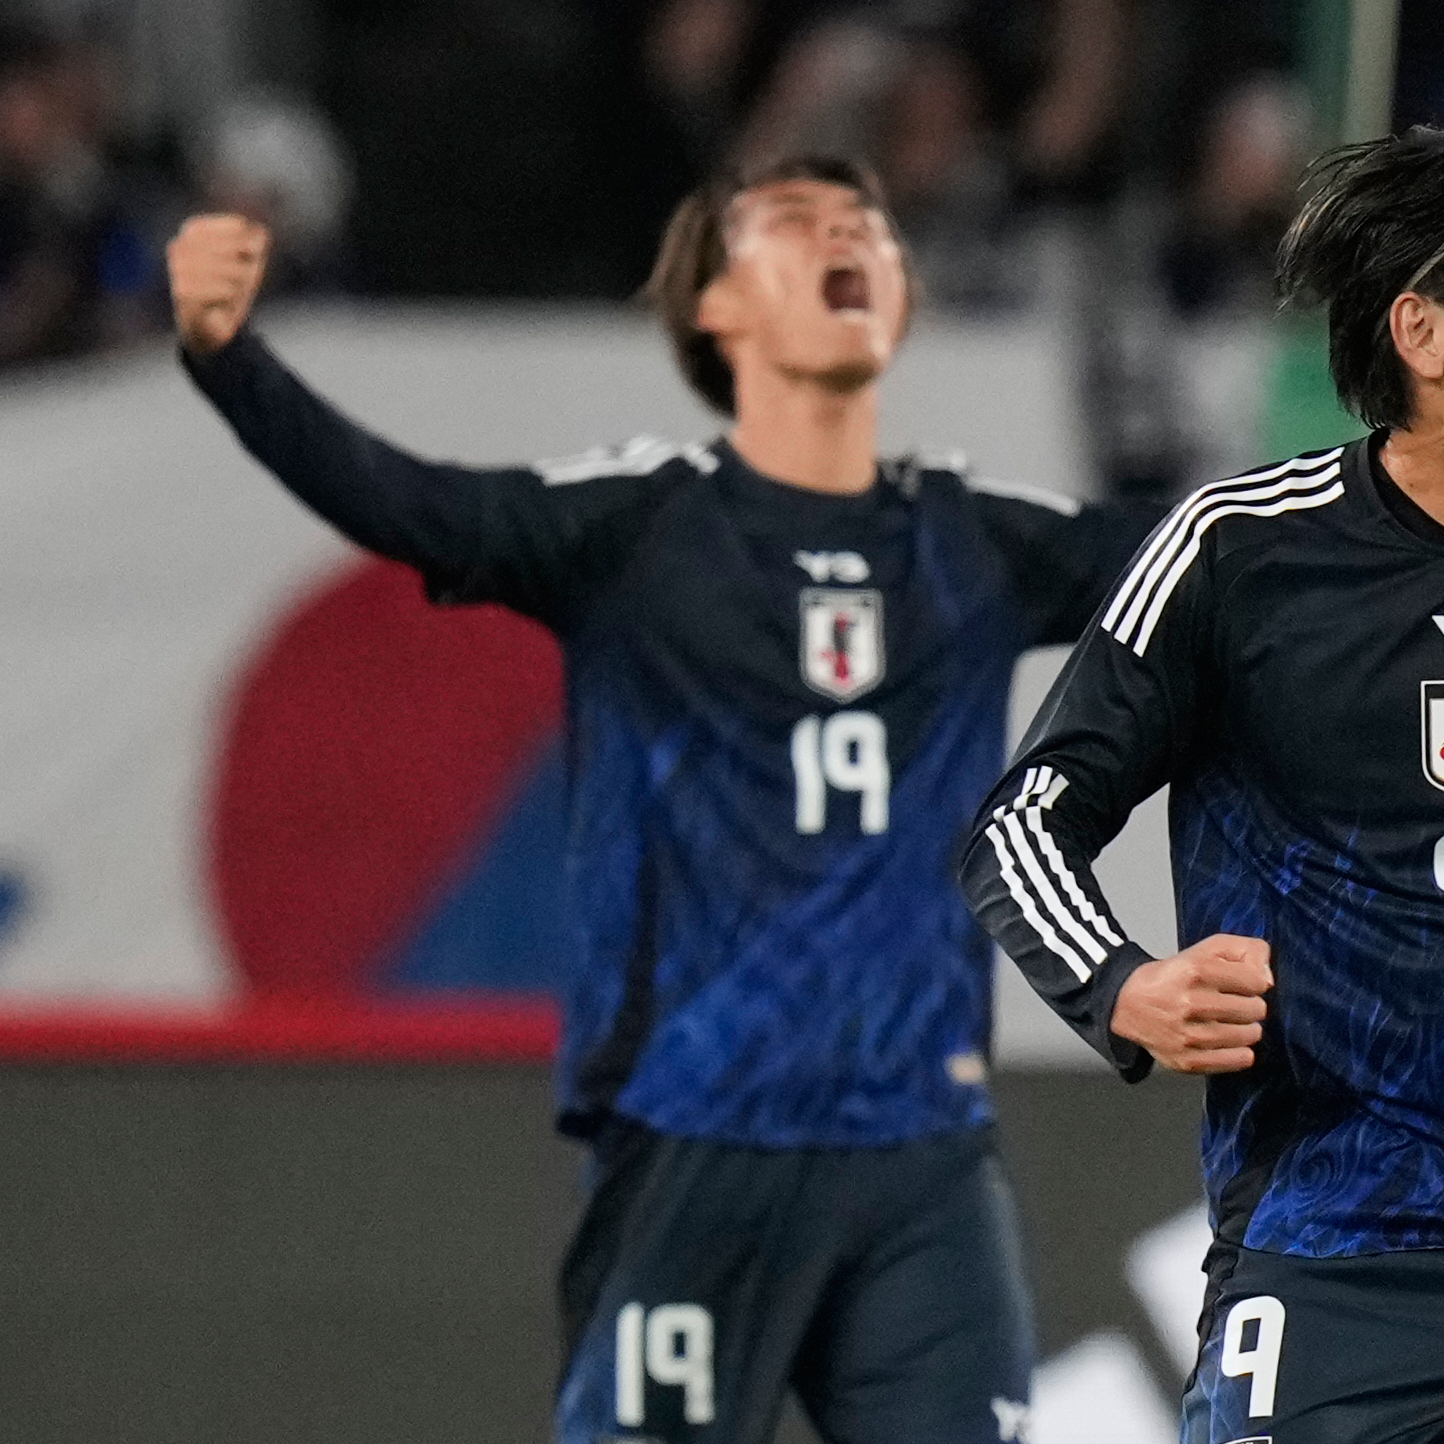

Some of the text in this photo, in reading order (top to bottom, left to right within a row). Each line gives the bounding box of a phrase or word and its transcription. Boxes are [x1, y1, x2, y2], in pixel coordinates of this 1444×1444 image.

[792, 710, 889, 834] 19
[615, 1302, 716, 1427] 19
[1221, 1295, 1286, 1418] 9
